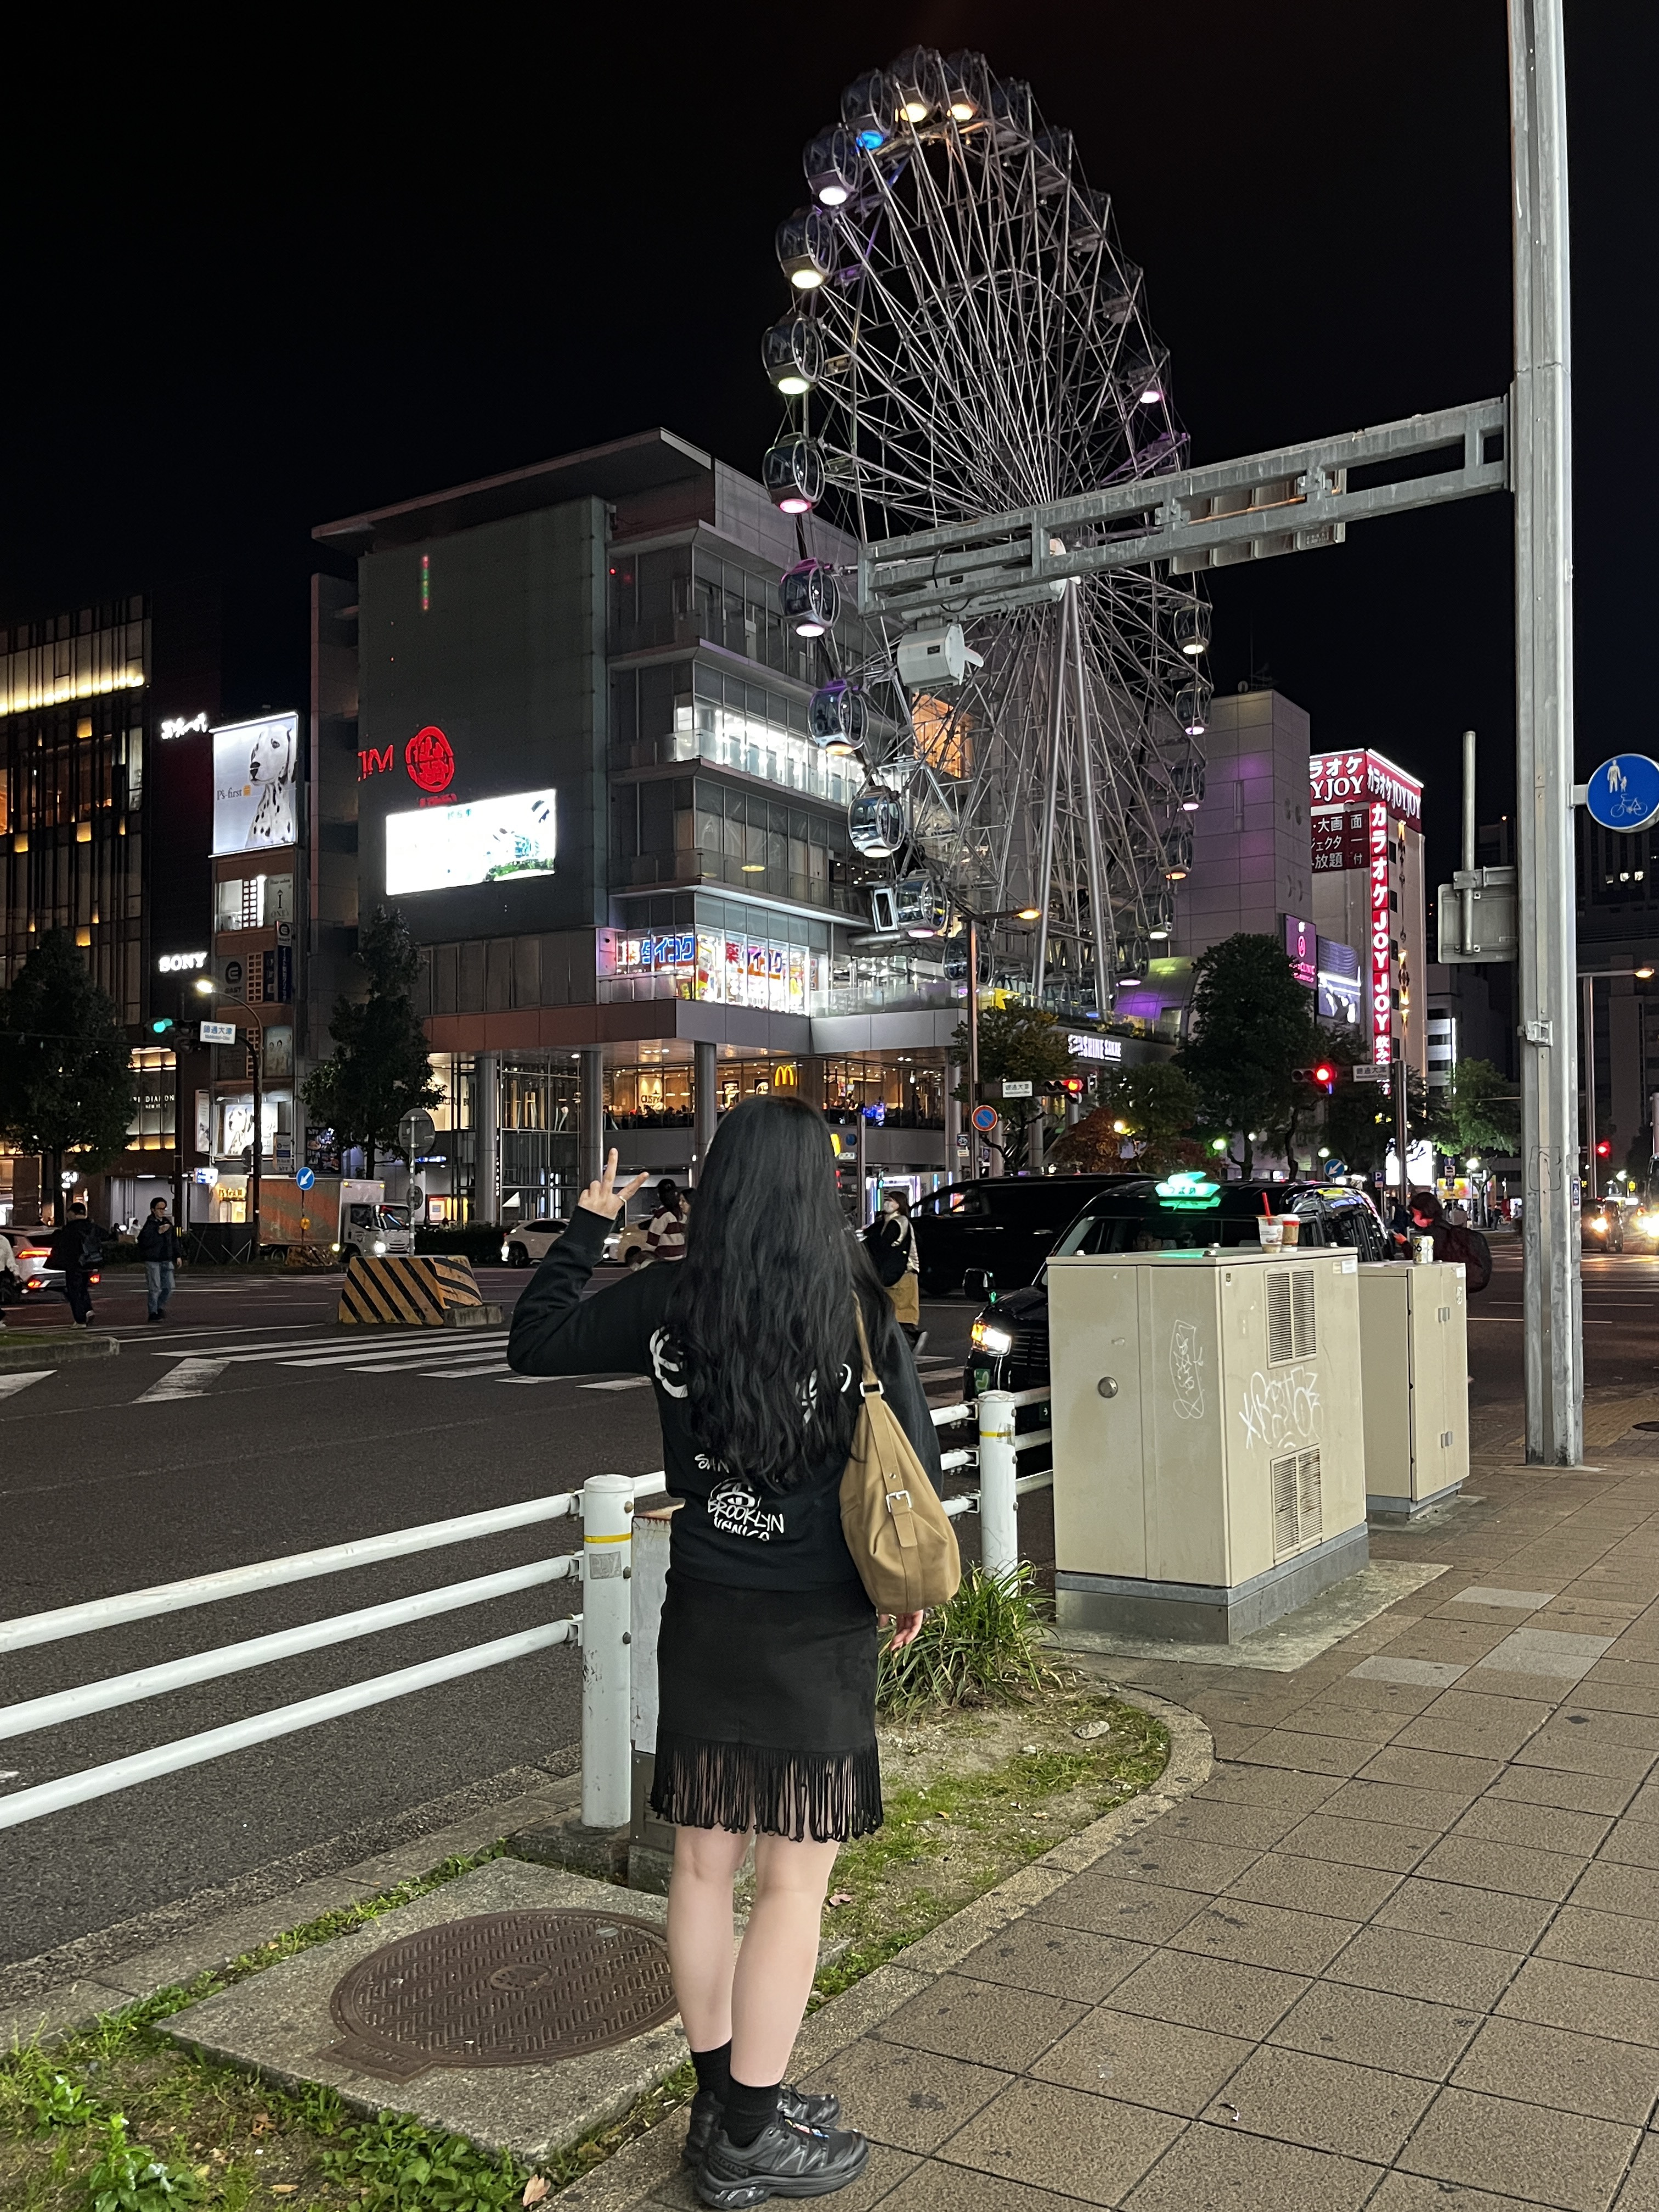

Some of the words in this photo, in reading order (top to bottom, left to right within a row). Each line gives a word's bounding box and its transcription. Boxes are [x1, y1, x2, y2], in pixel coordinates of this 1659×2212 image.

[1310, 775, 1364, 802] YJOY
[159, 952, 207, 972] SONY
[1375, 1172, 1382, 1180] P
[708, 1499, 785, 1533] BROOKLYN
